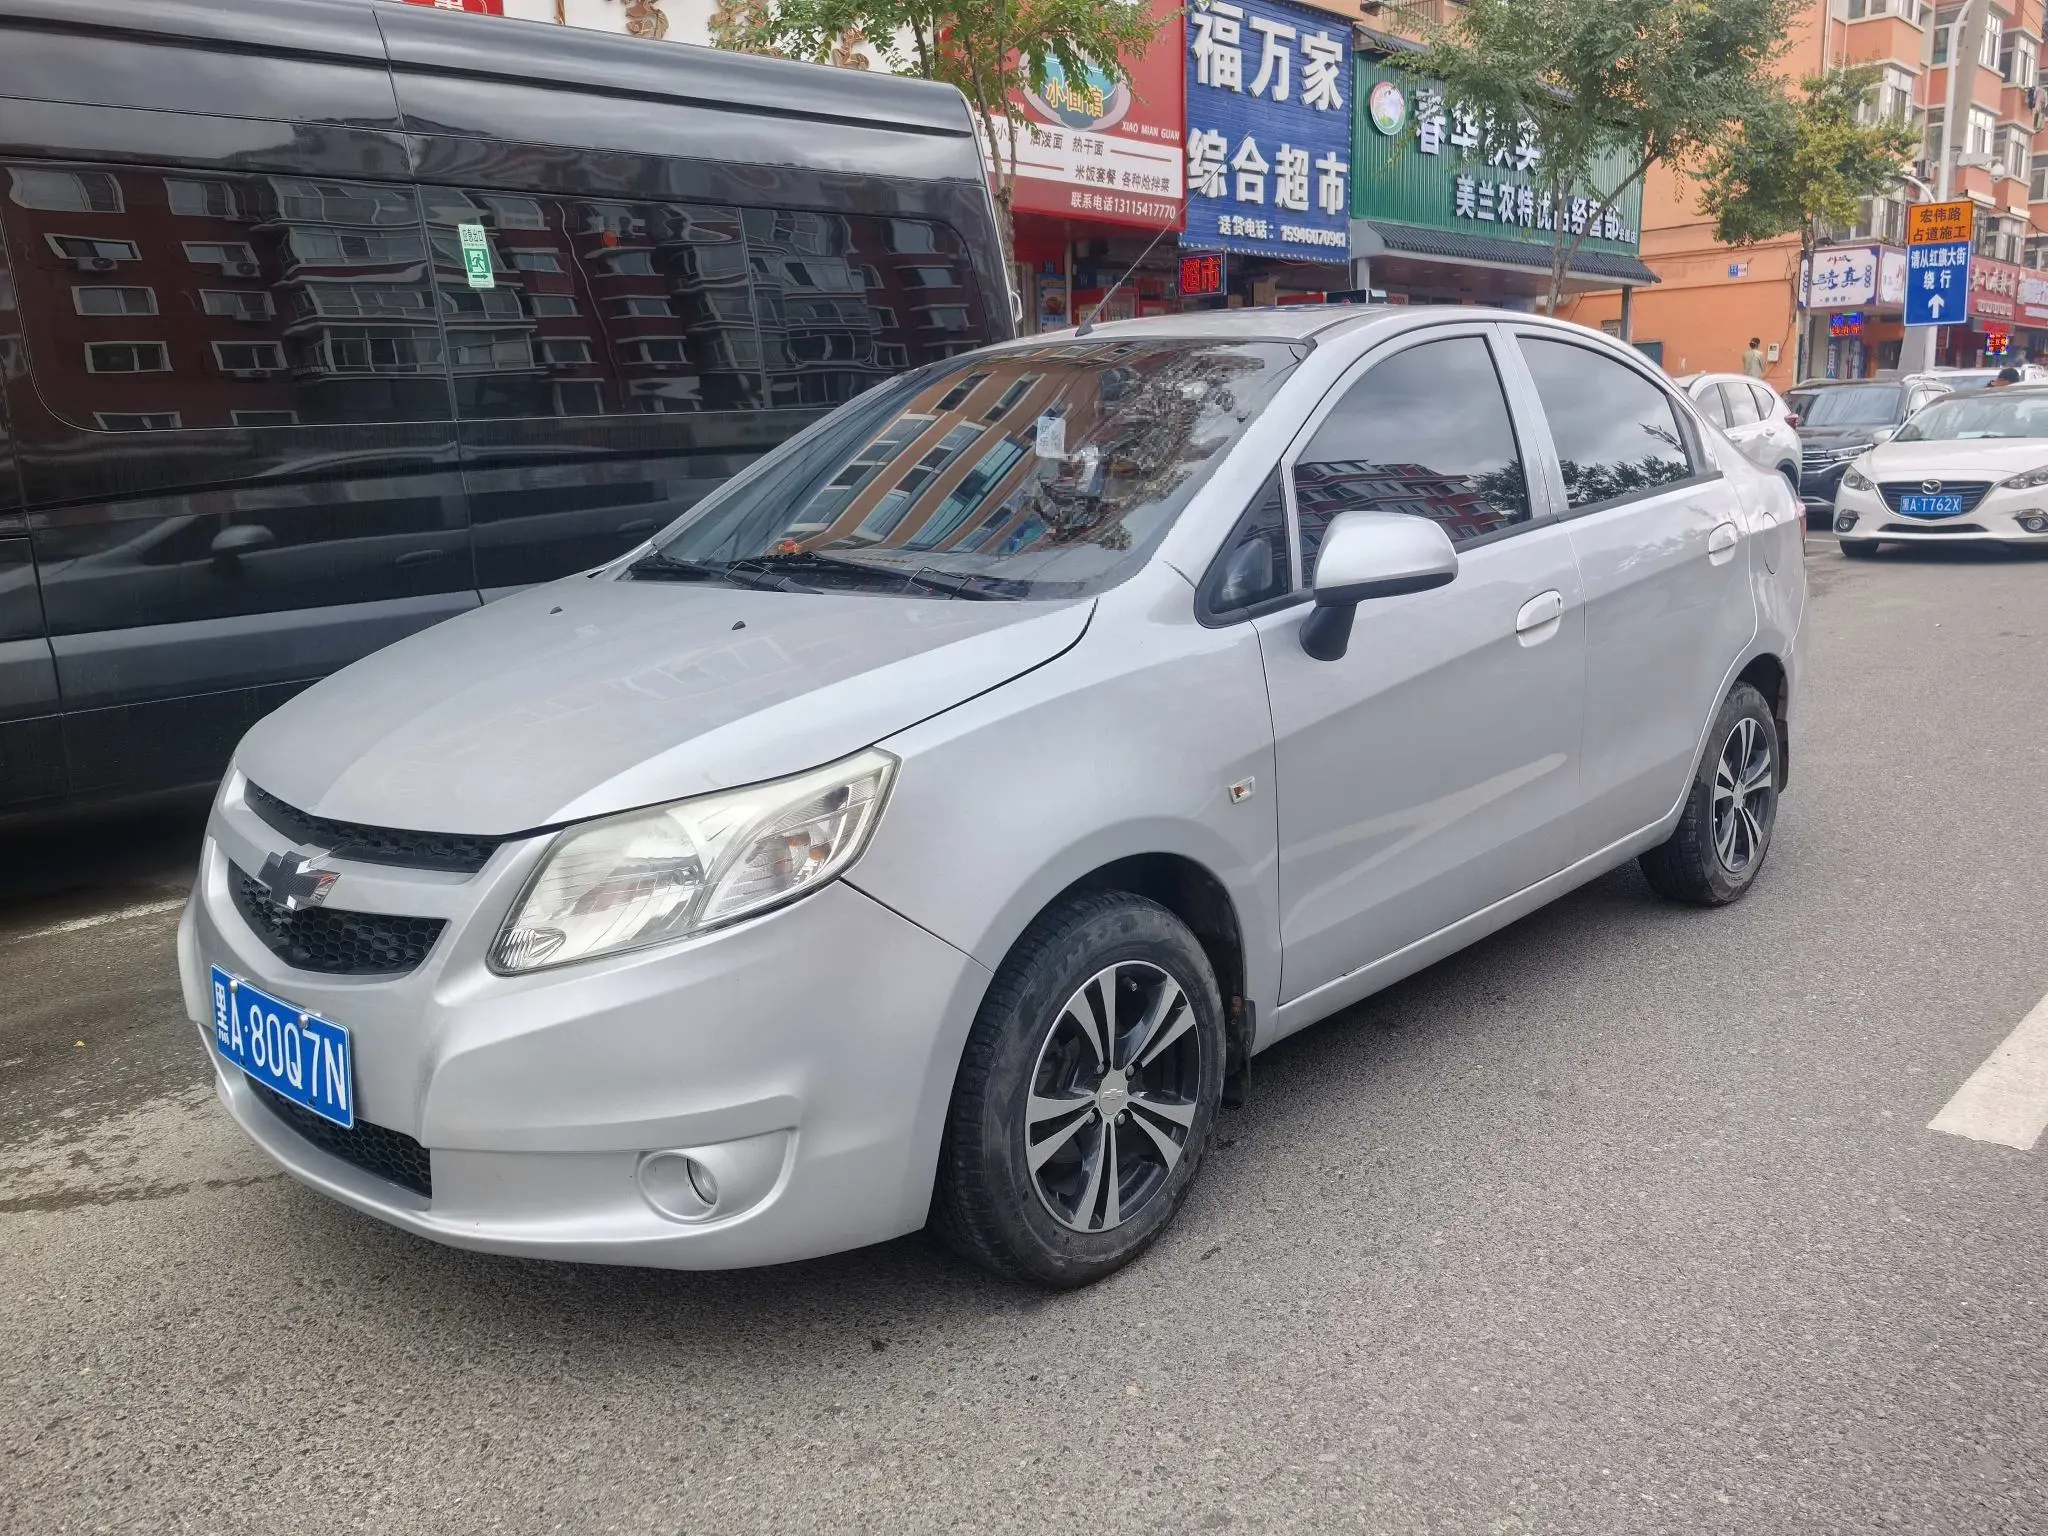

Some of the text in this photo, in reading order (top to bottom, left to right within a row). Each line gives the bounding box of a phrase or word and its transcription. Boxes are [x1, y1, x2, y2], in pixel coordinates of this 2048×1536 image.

[1191, 3, 1344, 112] 福万家
[1122, 121, 1180, 140] XIAO MIAN GUAN
[1072, 136, 1104, 157] 热干面
[1075, 164, 1117, 185] 米饭套餐
[1187, 127, 1347, 216] 综合超市
[1920, 207, 1961, 223] 宏伟路
[1913, 226, 1967, 242] 占道施工
[1911, 247, 1967, 270] 请从红旗大街
[1182, 256, 1220, 292] 超市
[1923, 270, 1952, 290] 绕行
